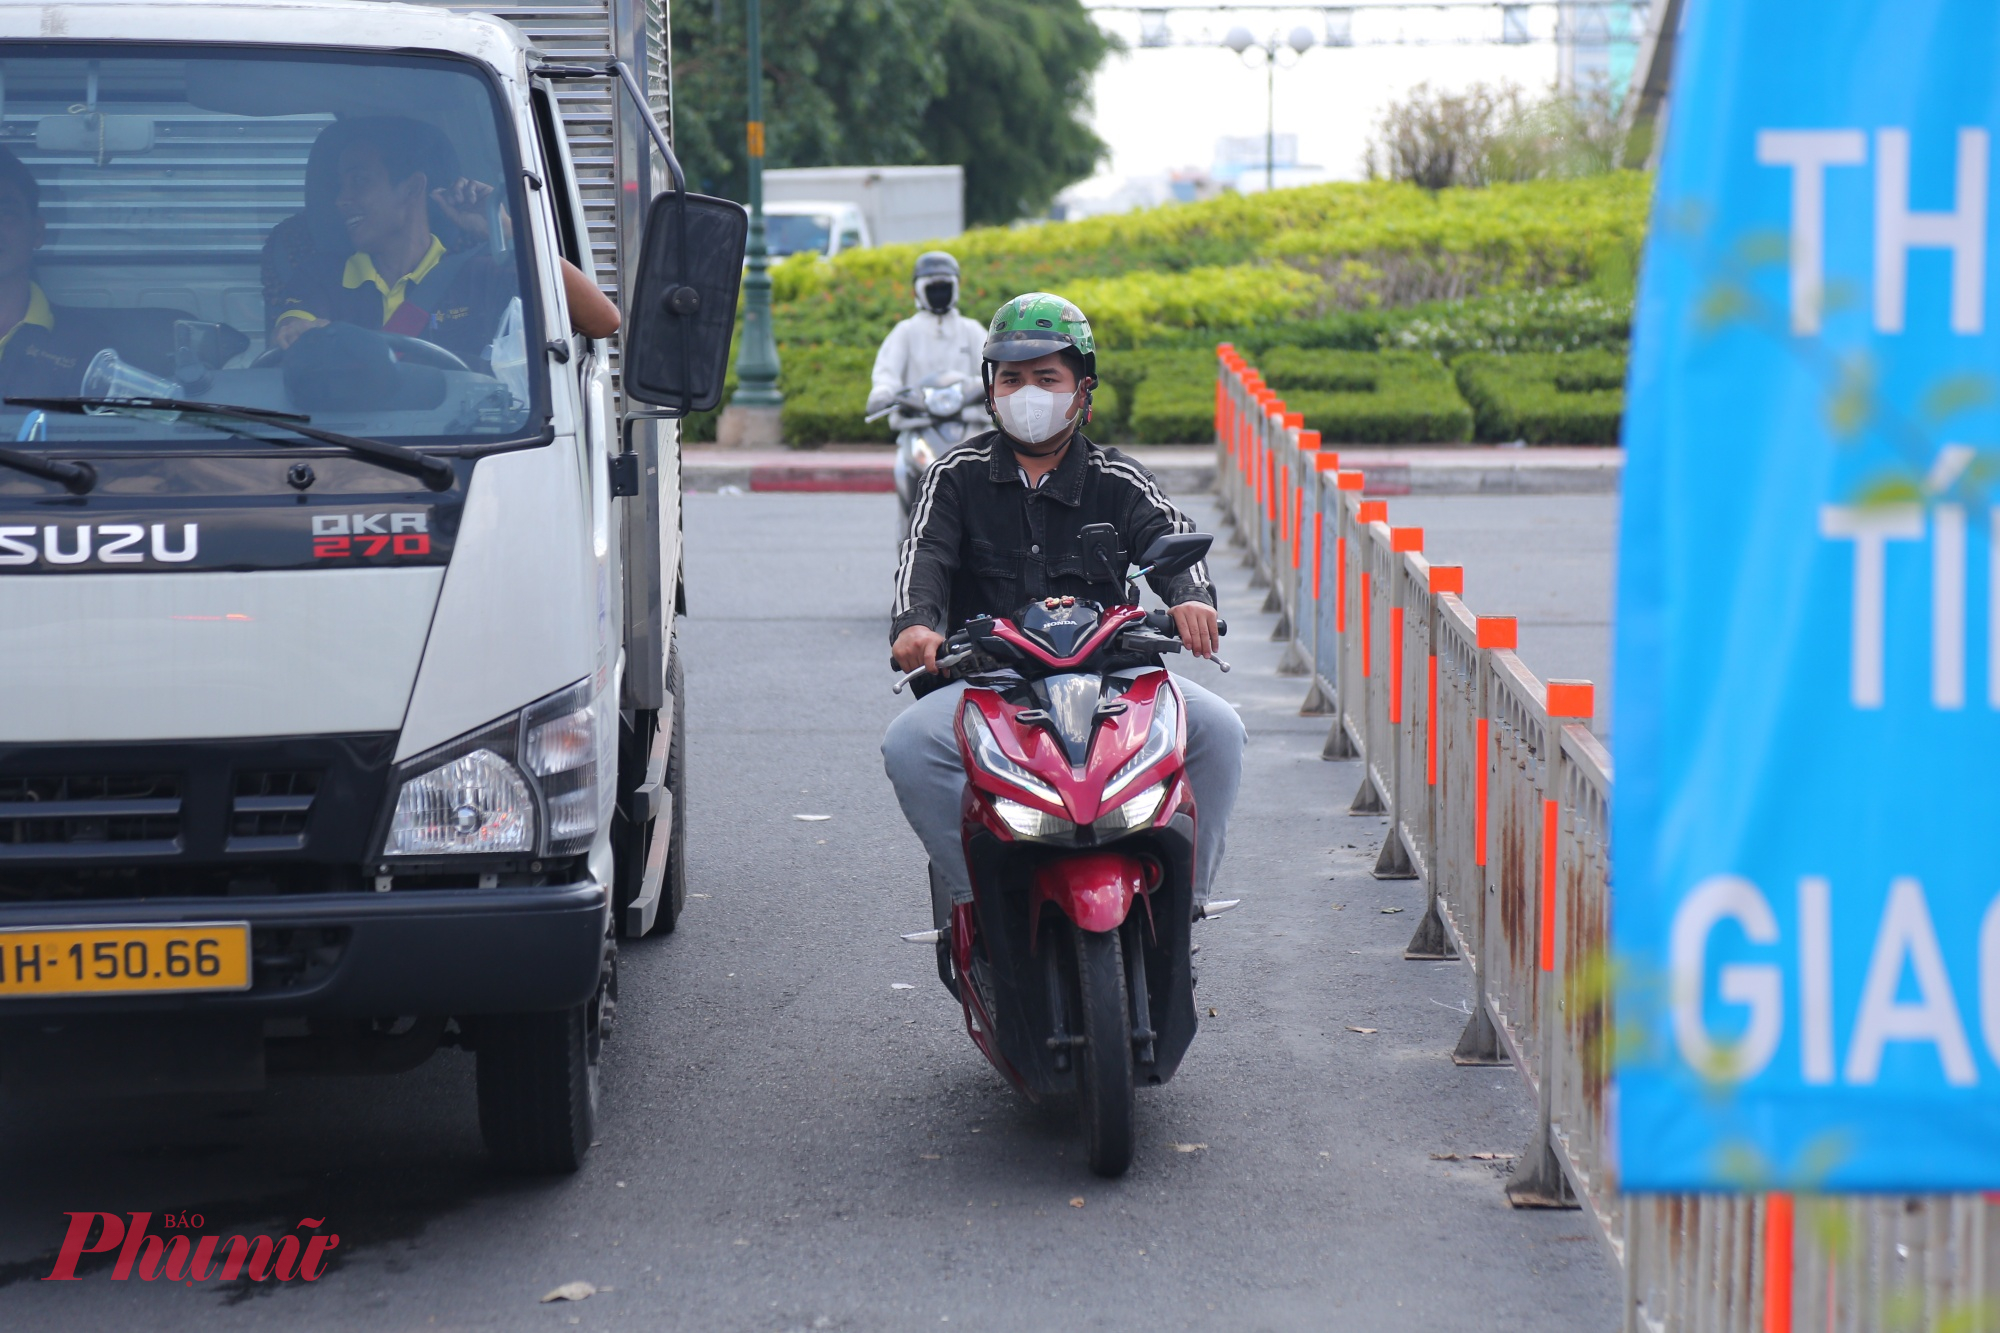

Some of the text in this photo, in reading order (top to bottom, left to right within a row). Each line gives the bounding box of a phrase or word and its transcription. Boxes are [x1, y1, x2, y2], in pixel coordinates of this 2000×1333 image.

[1757, 127, 1989, 335] TH
[312, 513, 428, 535] QKR
[313, 534, 430, 557] 270
[1818, 442, 2000, 711] TÍ
[1043, 620, 1078, 628] HONDA
[1669, 873, 2000, 1087] GIA
